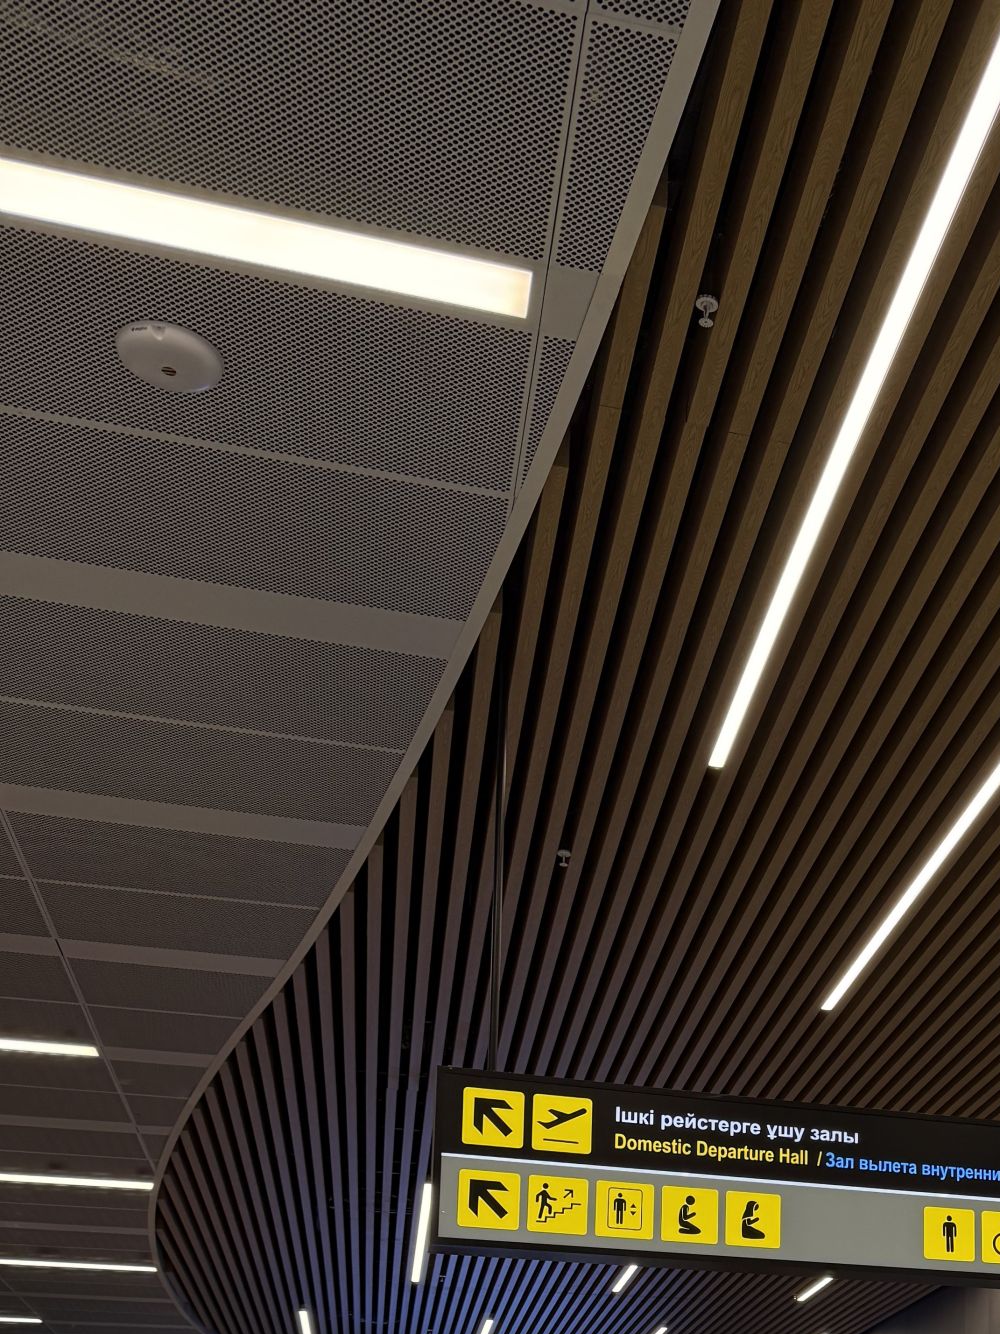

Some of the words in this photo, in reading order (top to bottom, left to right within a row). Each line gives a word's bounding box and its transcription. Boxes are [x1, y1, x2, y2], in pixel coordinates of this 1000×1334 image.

[615, 1106, 654, 1126] Ішкі
[660, 1112, 761, 1137] рейстерге
[810, 1129, 860, 1145] залы
[614, 1133, 692, 1155] Domestic
[696, 1140, 775, 1163] Departure
[779, 1148, 809, 1166] Hall
[816, 1151, 823, 1167] /
[825, 1151, 855, 1169] Зал
[859, 1157, 918, 1175] вылета
